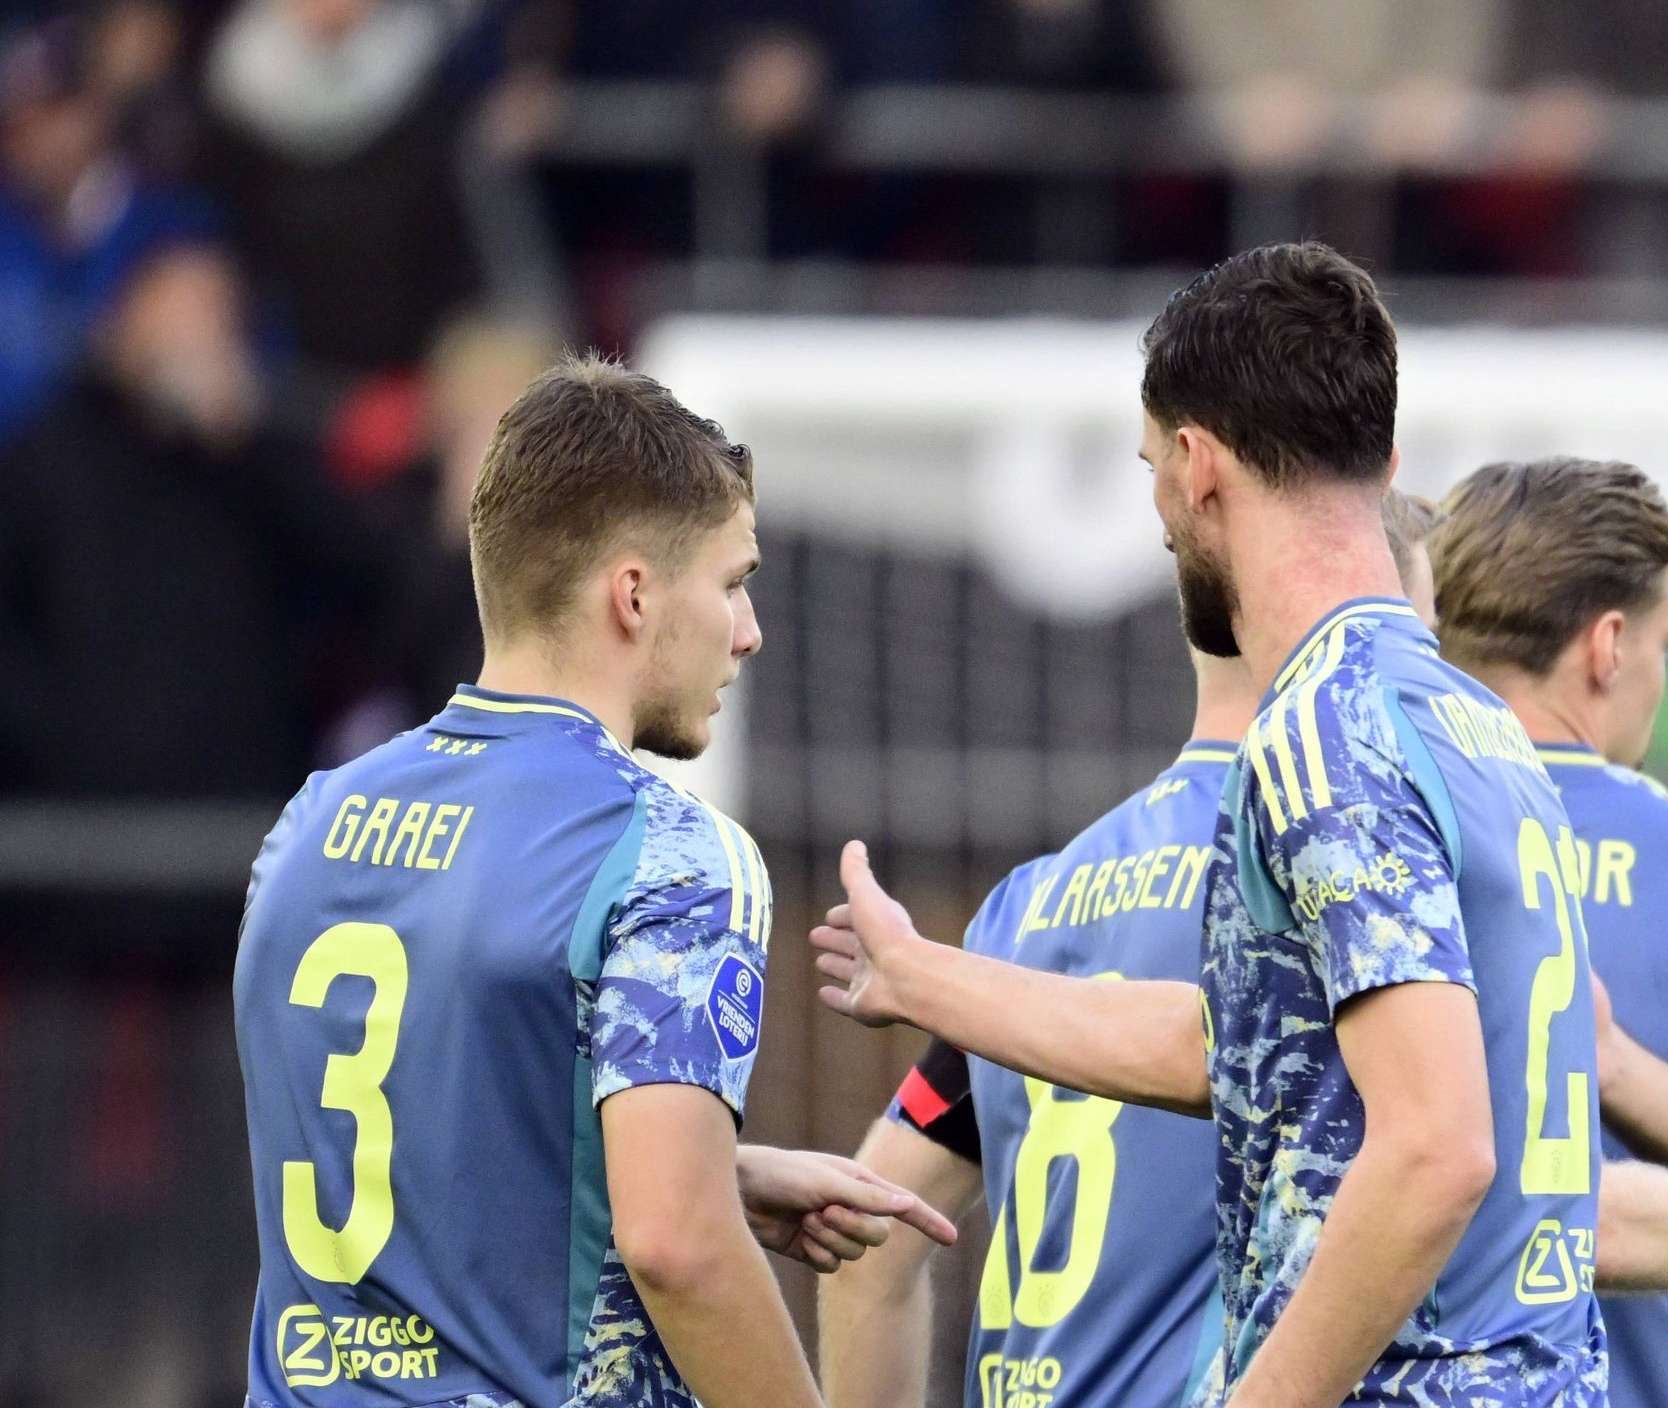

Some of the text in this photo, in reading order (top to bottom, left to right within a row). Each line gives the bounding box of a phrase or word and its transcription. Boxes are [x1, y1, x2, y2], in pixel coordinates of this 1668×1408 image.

[323, 794, 474, 870] GAAEI
[717, 995, 755, 1039] VRIENDEN
[1518, 817, 1590, 1195] 2
[282, 922, 408, 1286] 3
[332, 1314, 434, 1347] ZIGGO
[339, 1348, 438, 1380] SPORT
